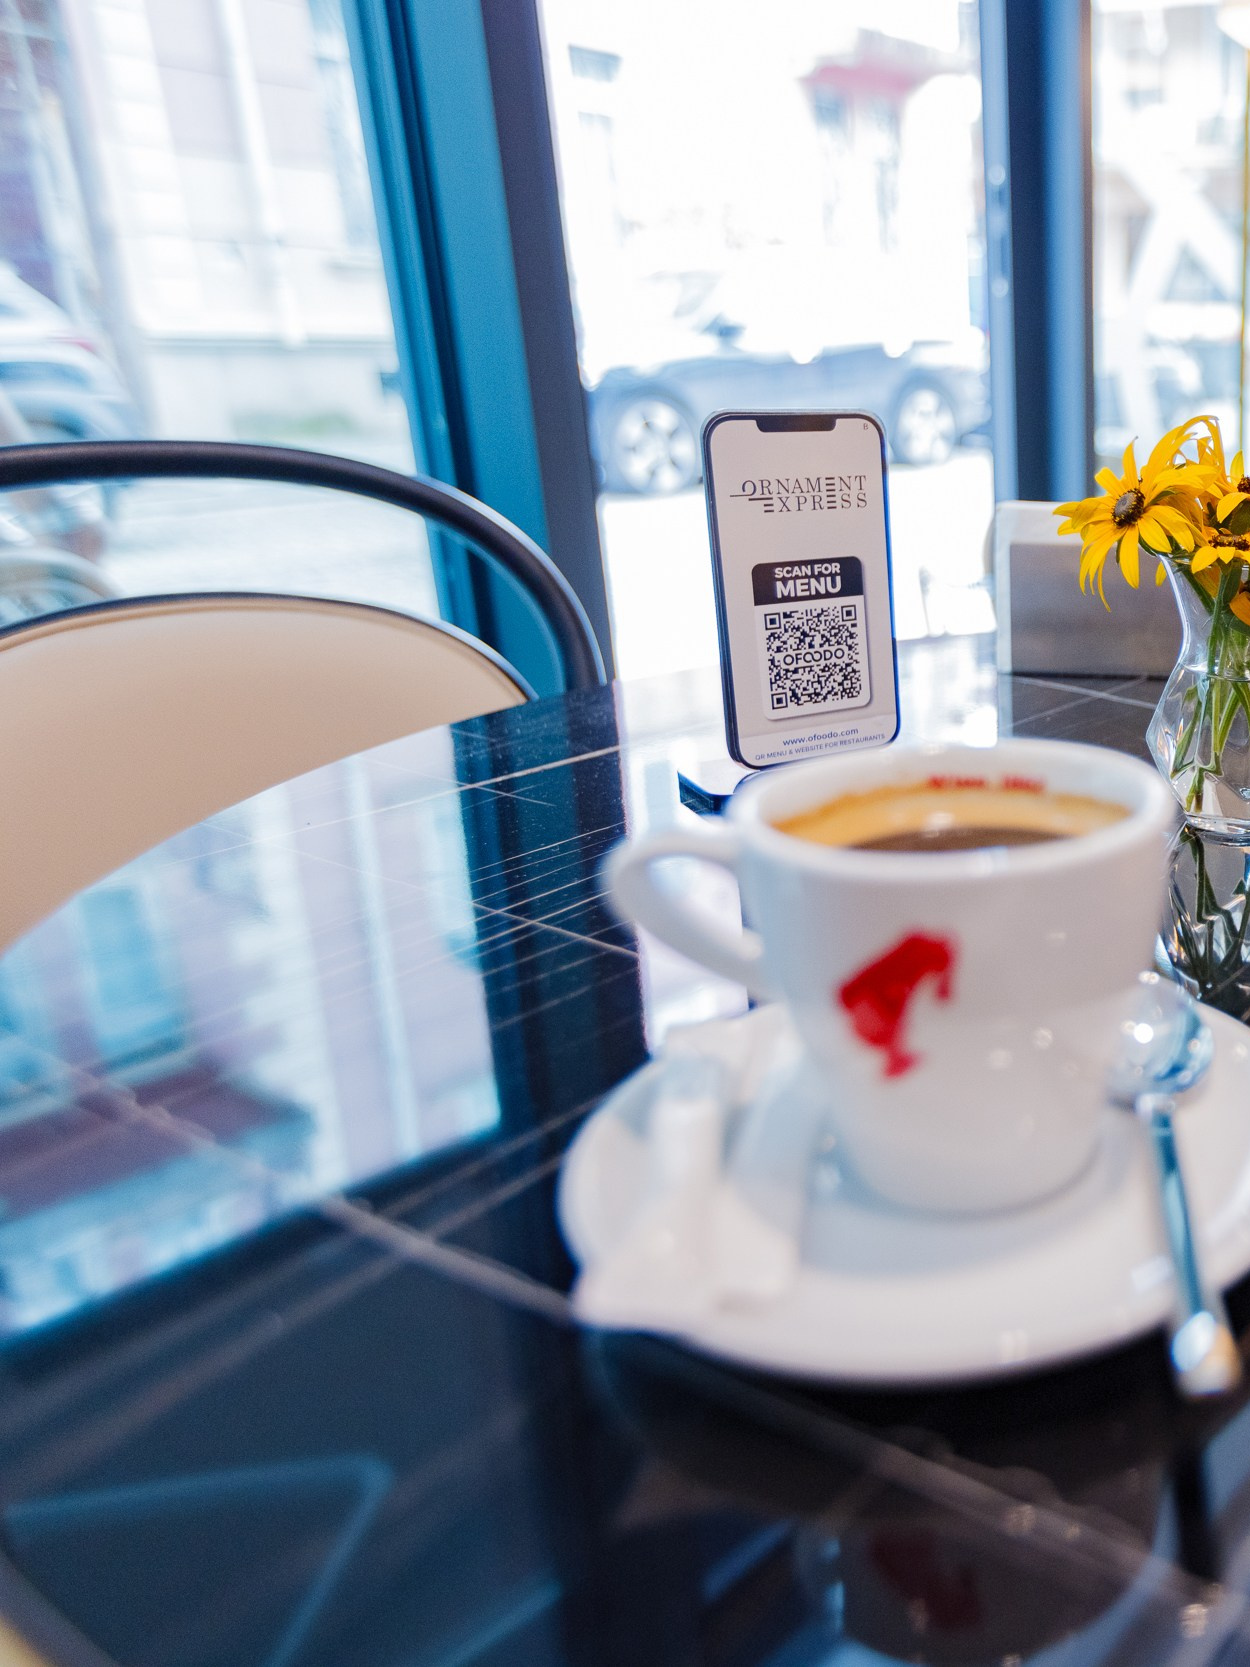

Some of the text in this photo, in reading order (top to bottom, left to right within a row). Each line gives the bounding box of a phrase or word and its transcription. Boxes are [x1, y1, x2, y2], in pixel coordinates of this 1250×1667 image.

[730, 475, 866, 496] ORNAMENT
[748, 492, 867, 513] EXPRESS
[774, 562, 841, 578] SCAN FOR
[776, 575, 842, 599] MENU
[783, 648, 845, 666] OFOODO
[767, 750, 787, 758] MENU
[794, 744, 824, 753] WEBSITE
[824, 741, 838, 749] FOR
[839, 733, 885, 746] RESTAURANTS
[782, 728, 859, 746] www.ofoodo.com
